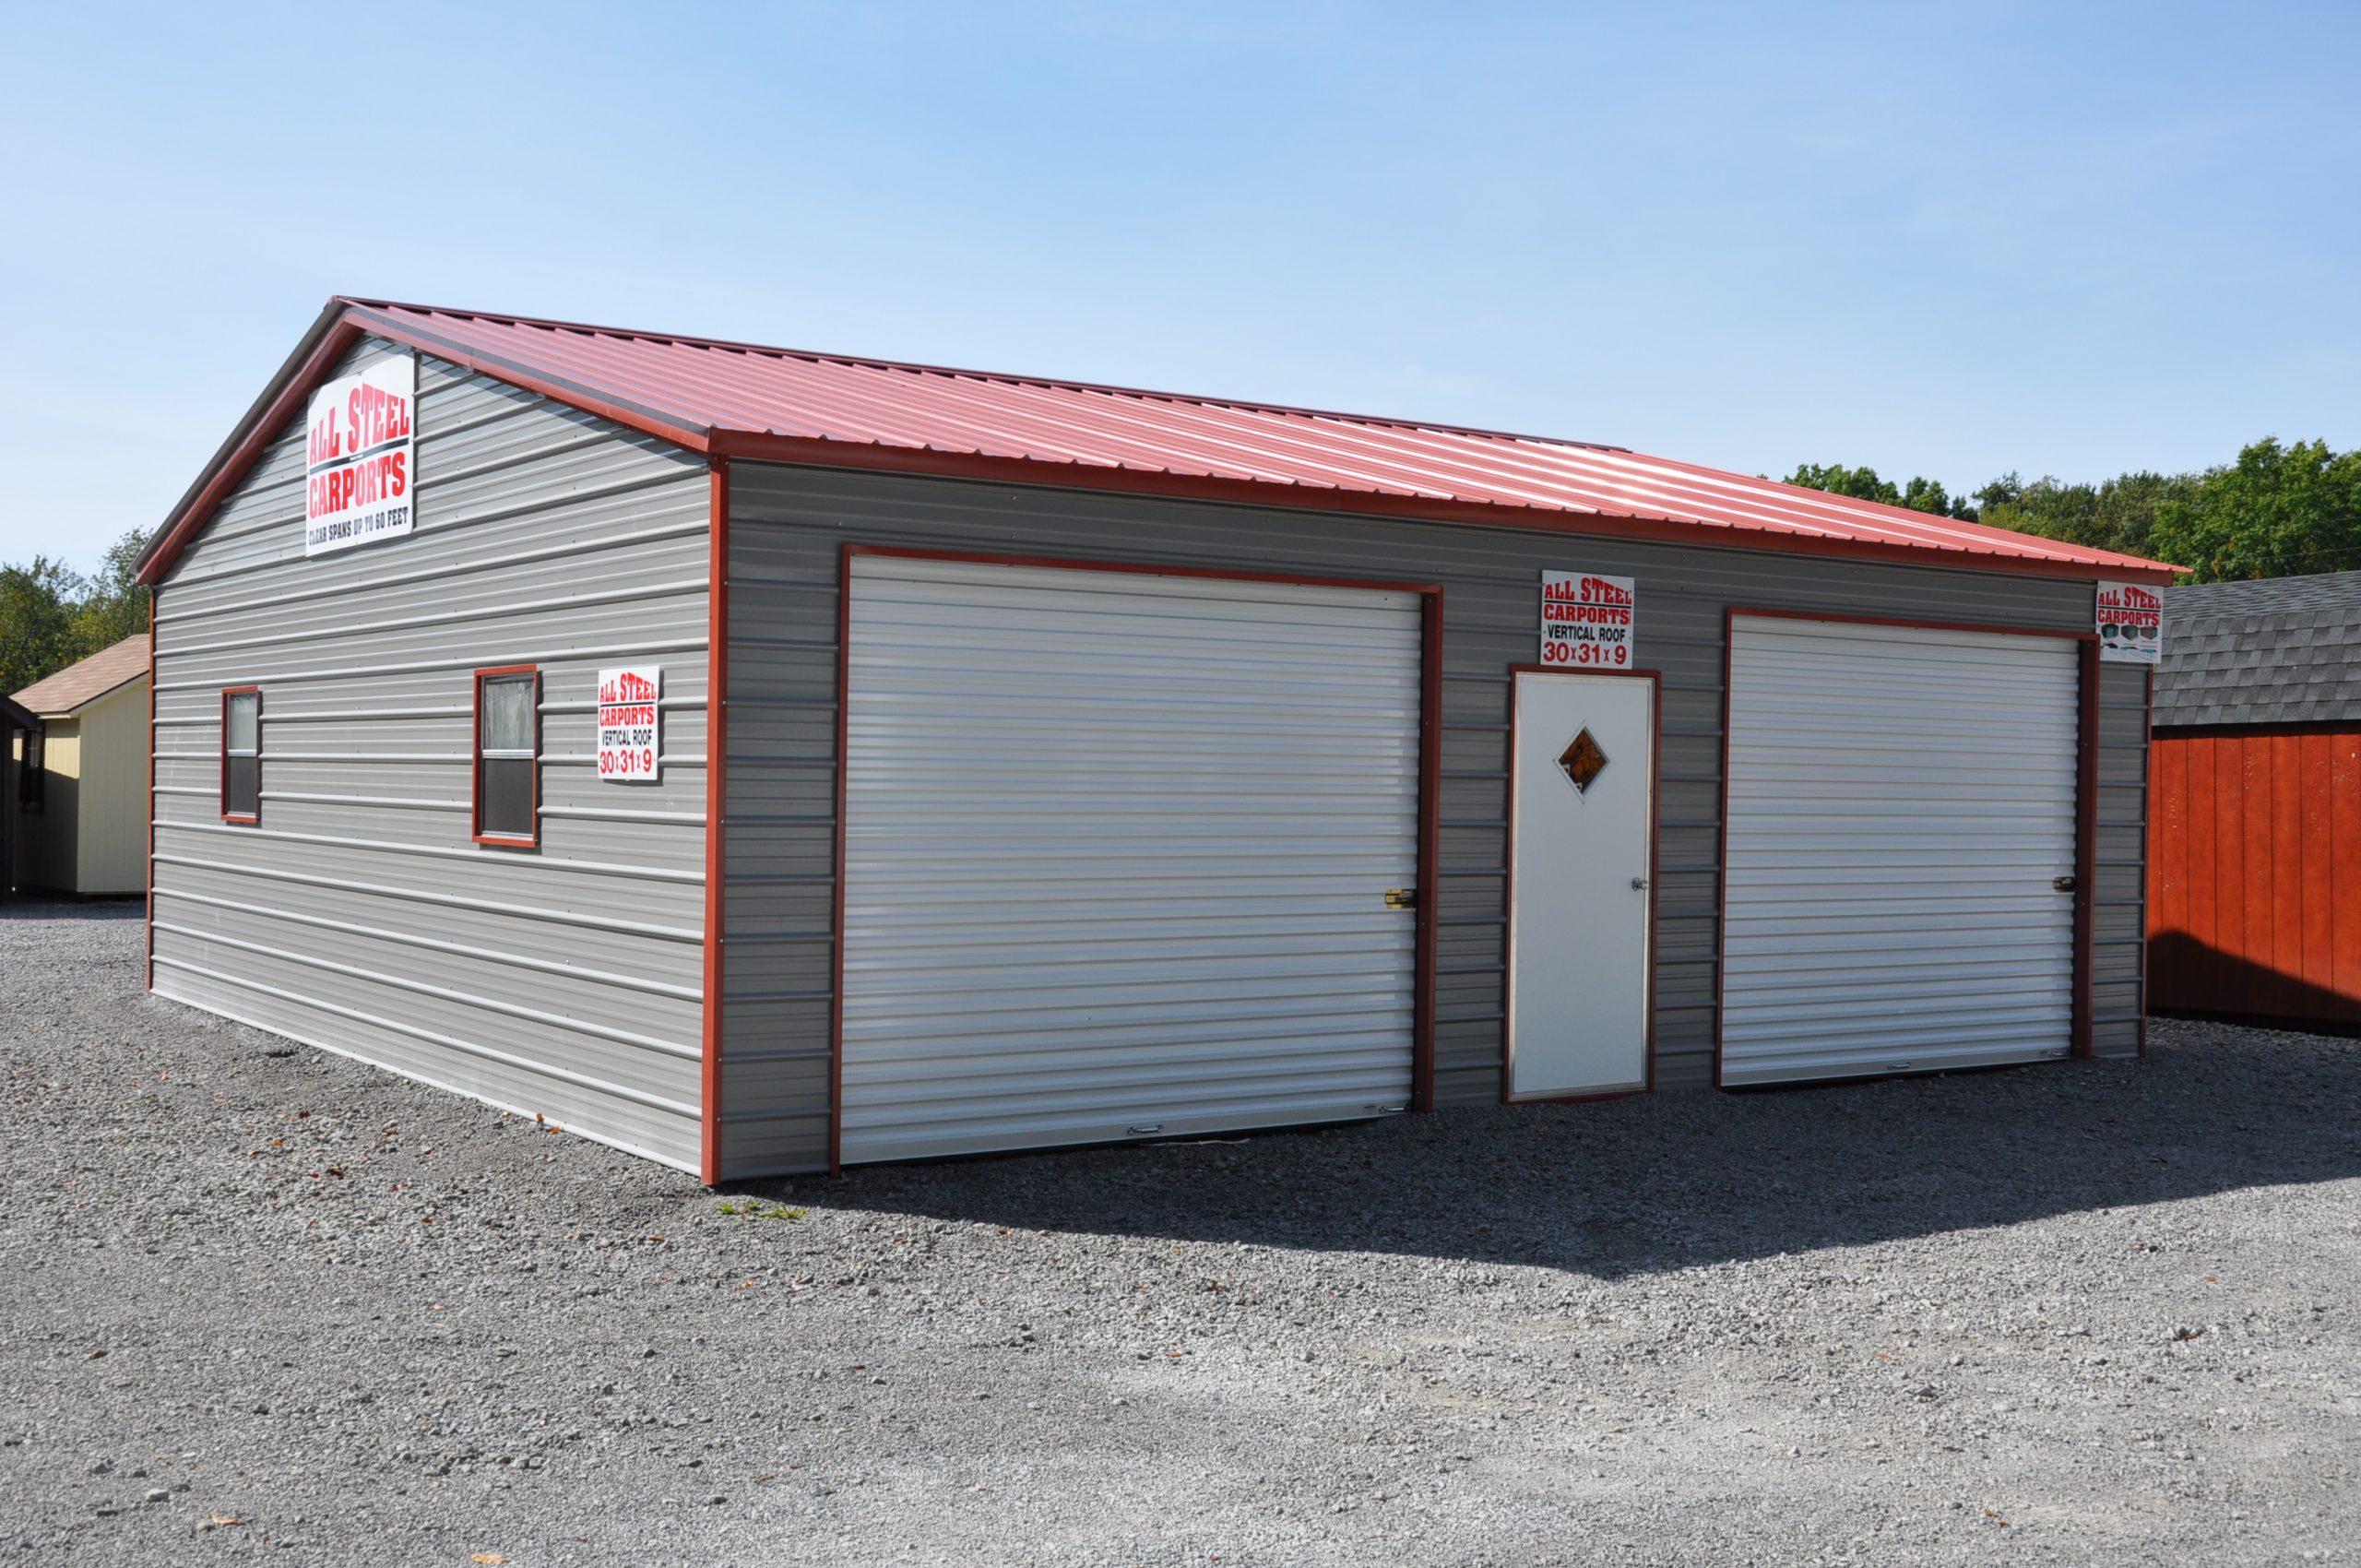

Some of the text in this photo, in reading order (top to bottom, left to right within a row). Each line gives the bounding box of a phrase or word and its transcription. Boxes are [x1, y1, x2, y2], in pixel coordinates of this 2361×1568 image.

[310, 383, 409, 466] ALL STEEL
[309, 452, 405, 519] CARPORTS
[309, 506, 409, 546] CLEAR SPANS UP TO 60 FEET
[1544, 576, 1631, 605] ALL STEEL
[2098, 586, 2161, 610] ALL STEEL
[1544, 604, 1631, 625] CARPORTS
[2097, 609, 2160, 626] CARPORTS
[1548, 624, 1626, 643] VERTICAL ROOF
[599, 672, 657, 703] ALL STEEL
[599, 706, 654, 727] CARPORTS
[601, 729, 652, 746] VERTICAL ROOF
